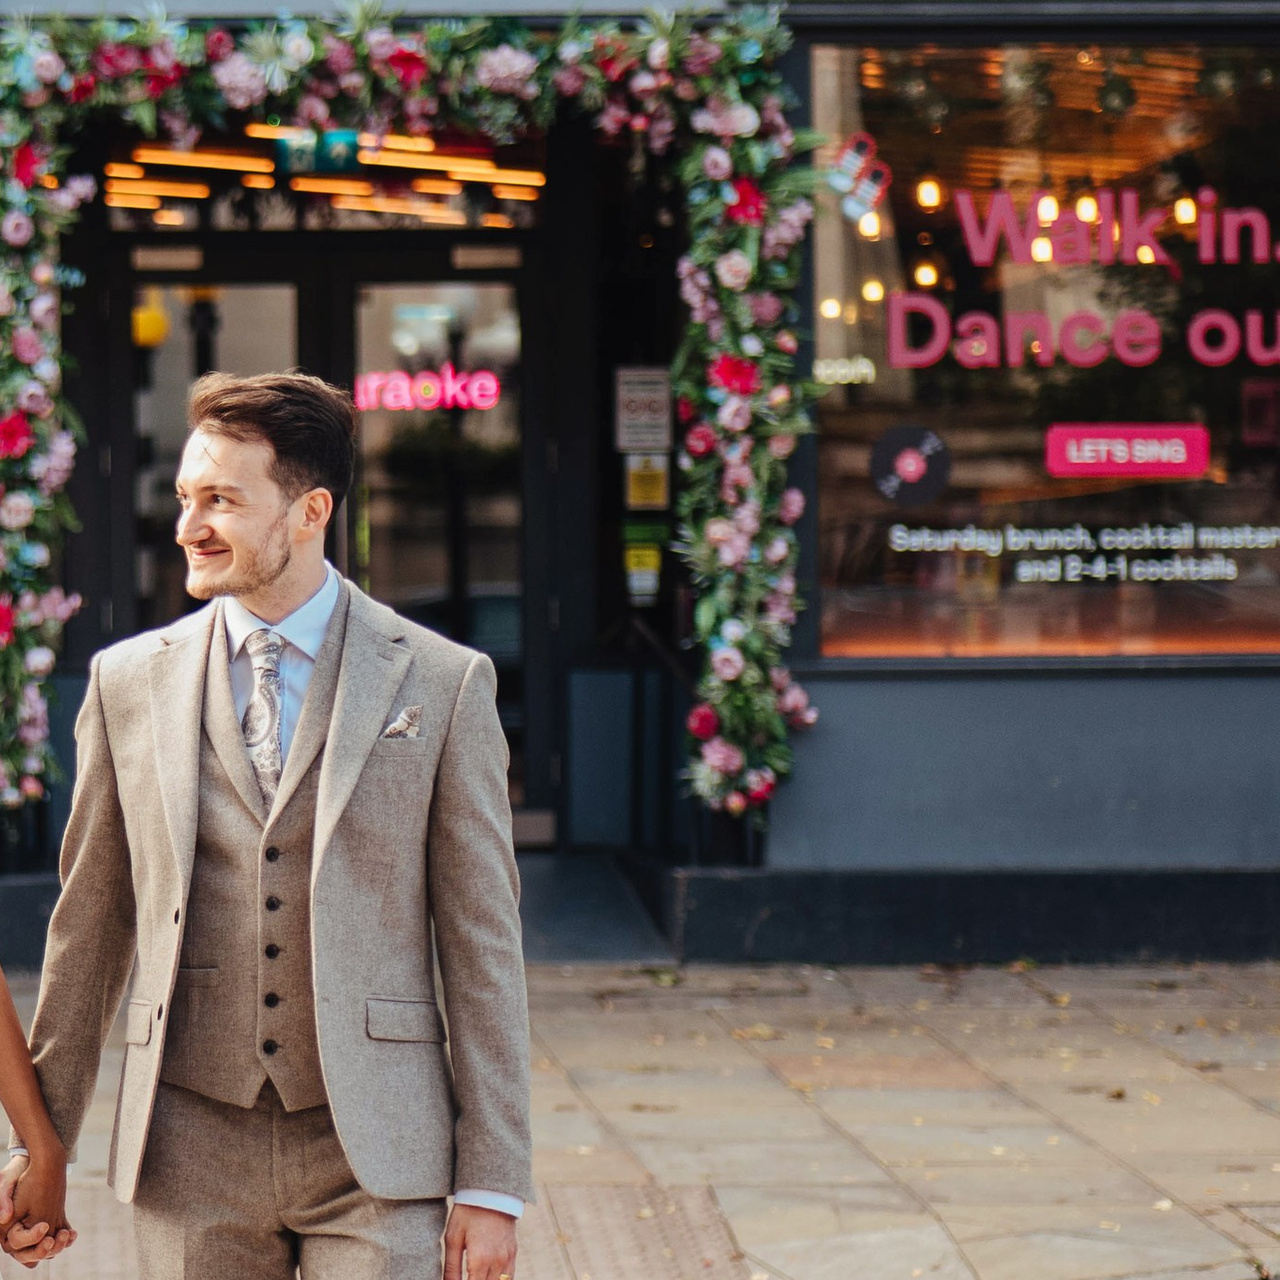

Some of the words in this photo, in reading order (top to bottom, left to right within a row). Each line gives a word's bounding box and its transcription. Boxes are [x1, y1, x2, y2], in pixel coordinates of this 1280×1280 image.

[952, 187, 1173, 267] Walk
[886, 291, 1163, 369] Dance
[1131, 438, 1186, 463] SING
[888, 523, 1003, 557] Saturday
[1099, 522, 1194, 550] cocktail
[1016, 554, 1061, 582] and
[1131, 552, 1238, 581] cocktails
